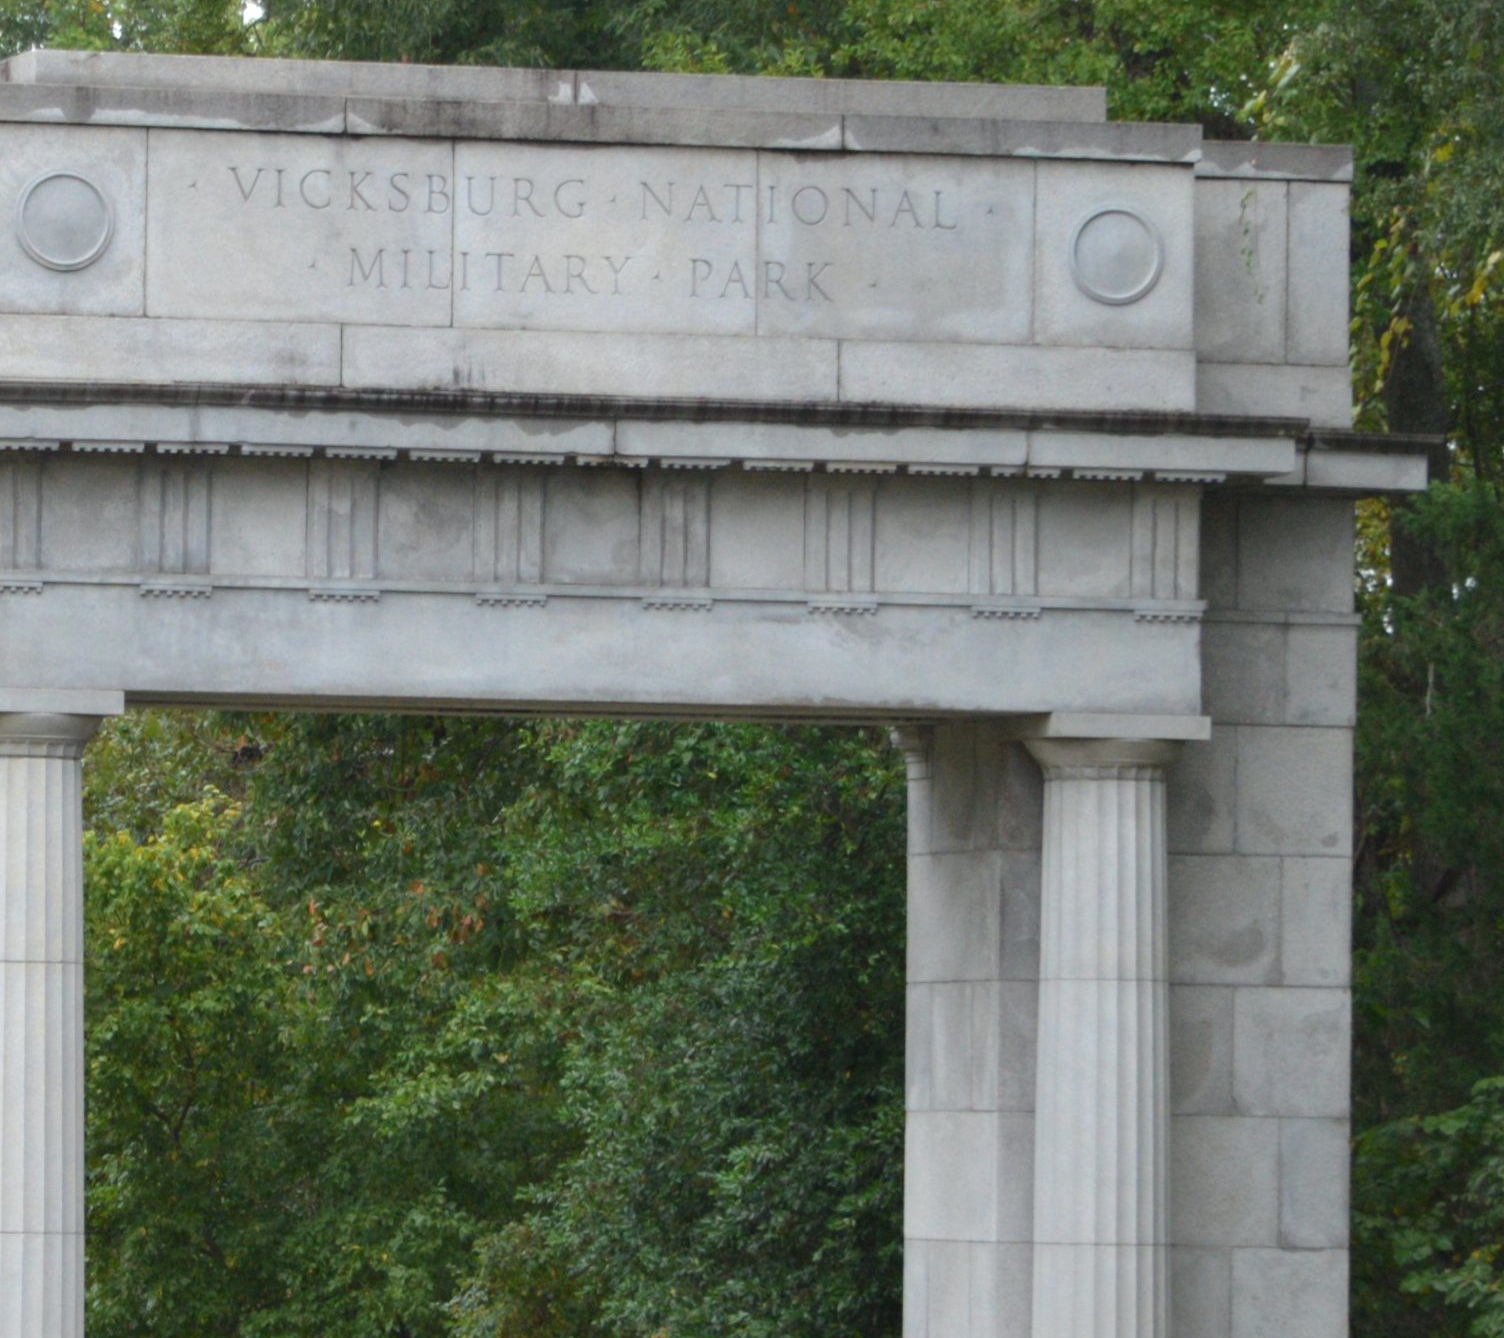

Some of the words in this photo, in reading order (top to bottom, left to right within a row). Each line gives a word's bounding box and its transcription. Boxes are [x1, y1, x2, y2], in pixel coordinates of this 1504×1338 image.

[226, 167, 587, 219] VICKSBURG
[639, 181, 957, 230] NATIONAL
[346, 248, 635, 296] MILITARY
[688, 258, 834, 303] PARK
